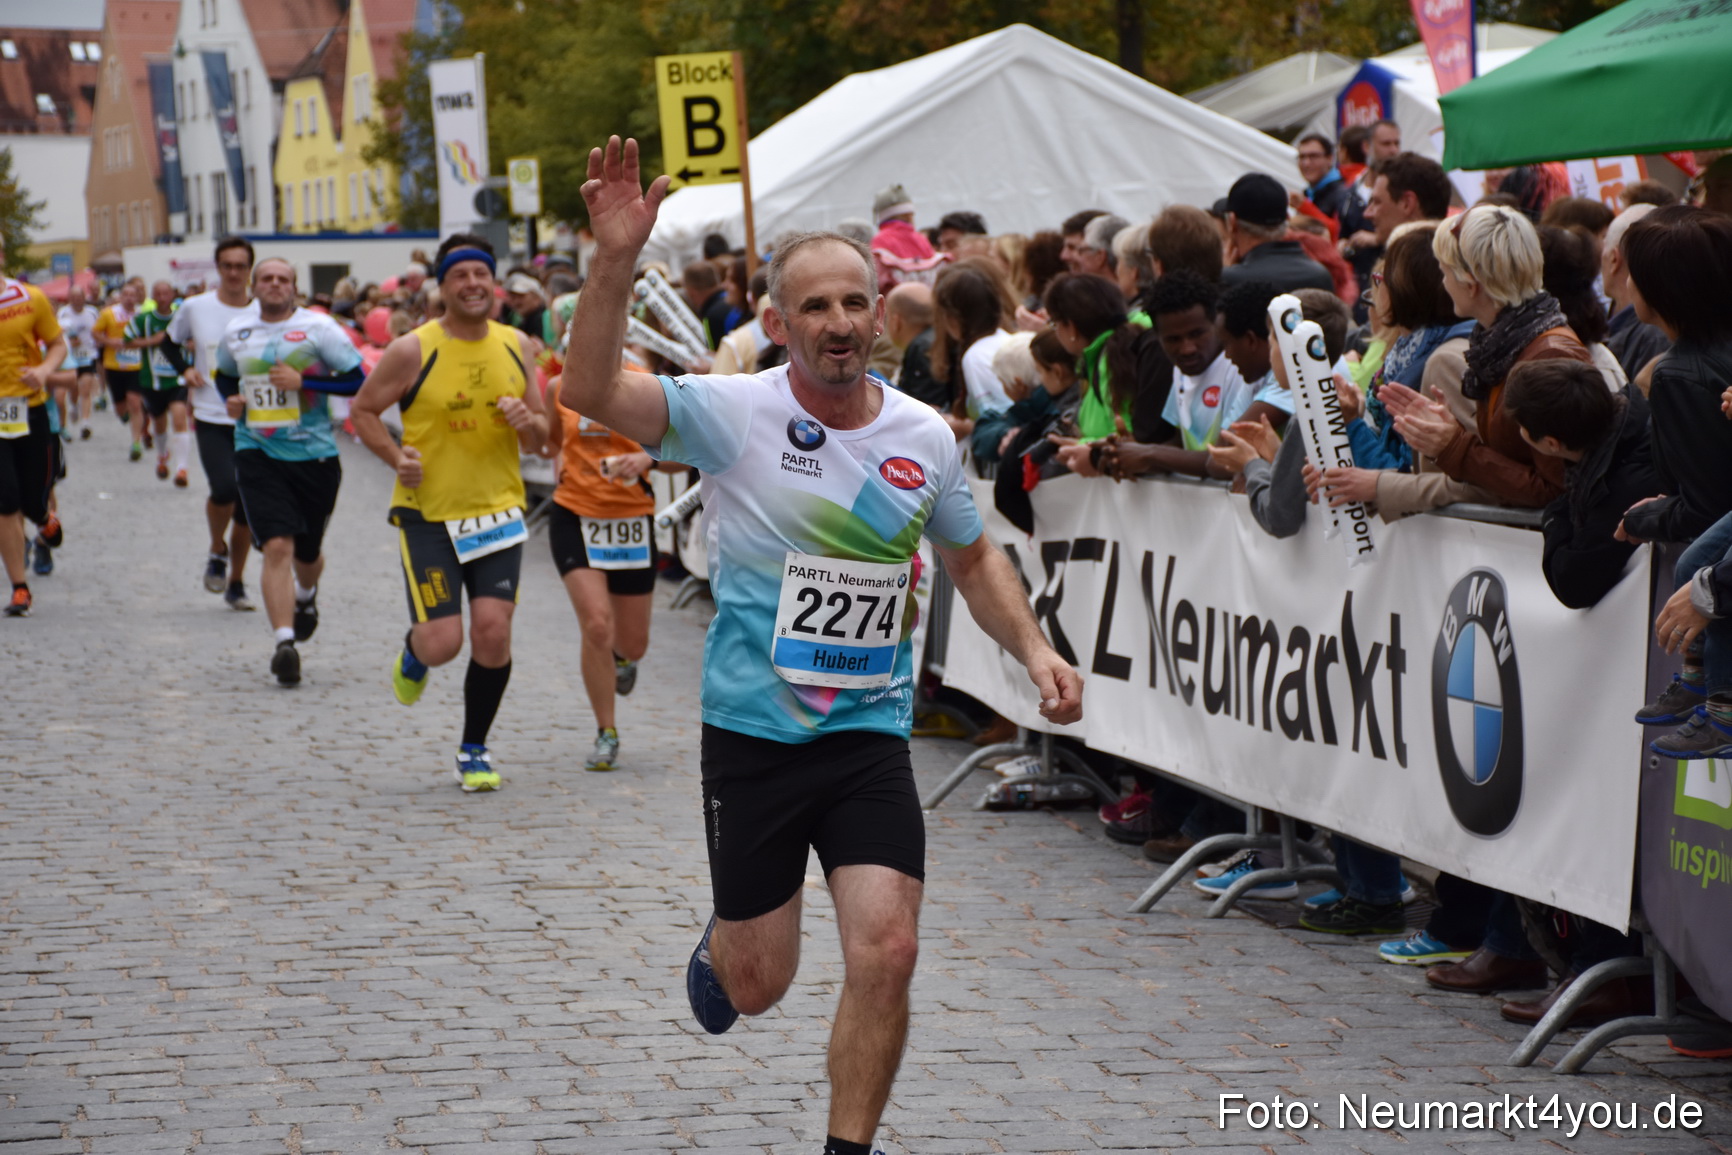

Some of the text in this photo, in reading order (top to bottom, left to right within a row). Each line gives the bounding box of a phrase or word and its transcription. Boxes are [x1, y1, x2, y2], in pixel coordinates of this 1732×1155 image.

[667, 59, 733, 84] Block
[683, 94, 725, 158] B
[253, 388, 288, 407] 518
[781, 462, 822, 479] Neumarkt
[782, 452, 823, 471] PARTL
[588, 521, 643, 544] 2198
[788, 565, 896, 588] PARTL Neumarkt
[791, 587, 897, 640] 2274
[1442, 576, 1512, 666] BMW
[781, 628, 787, 636] B
[813, 649, 869, 671] Hubert
[1141, 550, 1408, 769] Neumarkt
